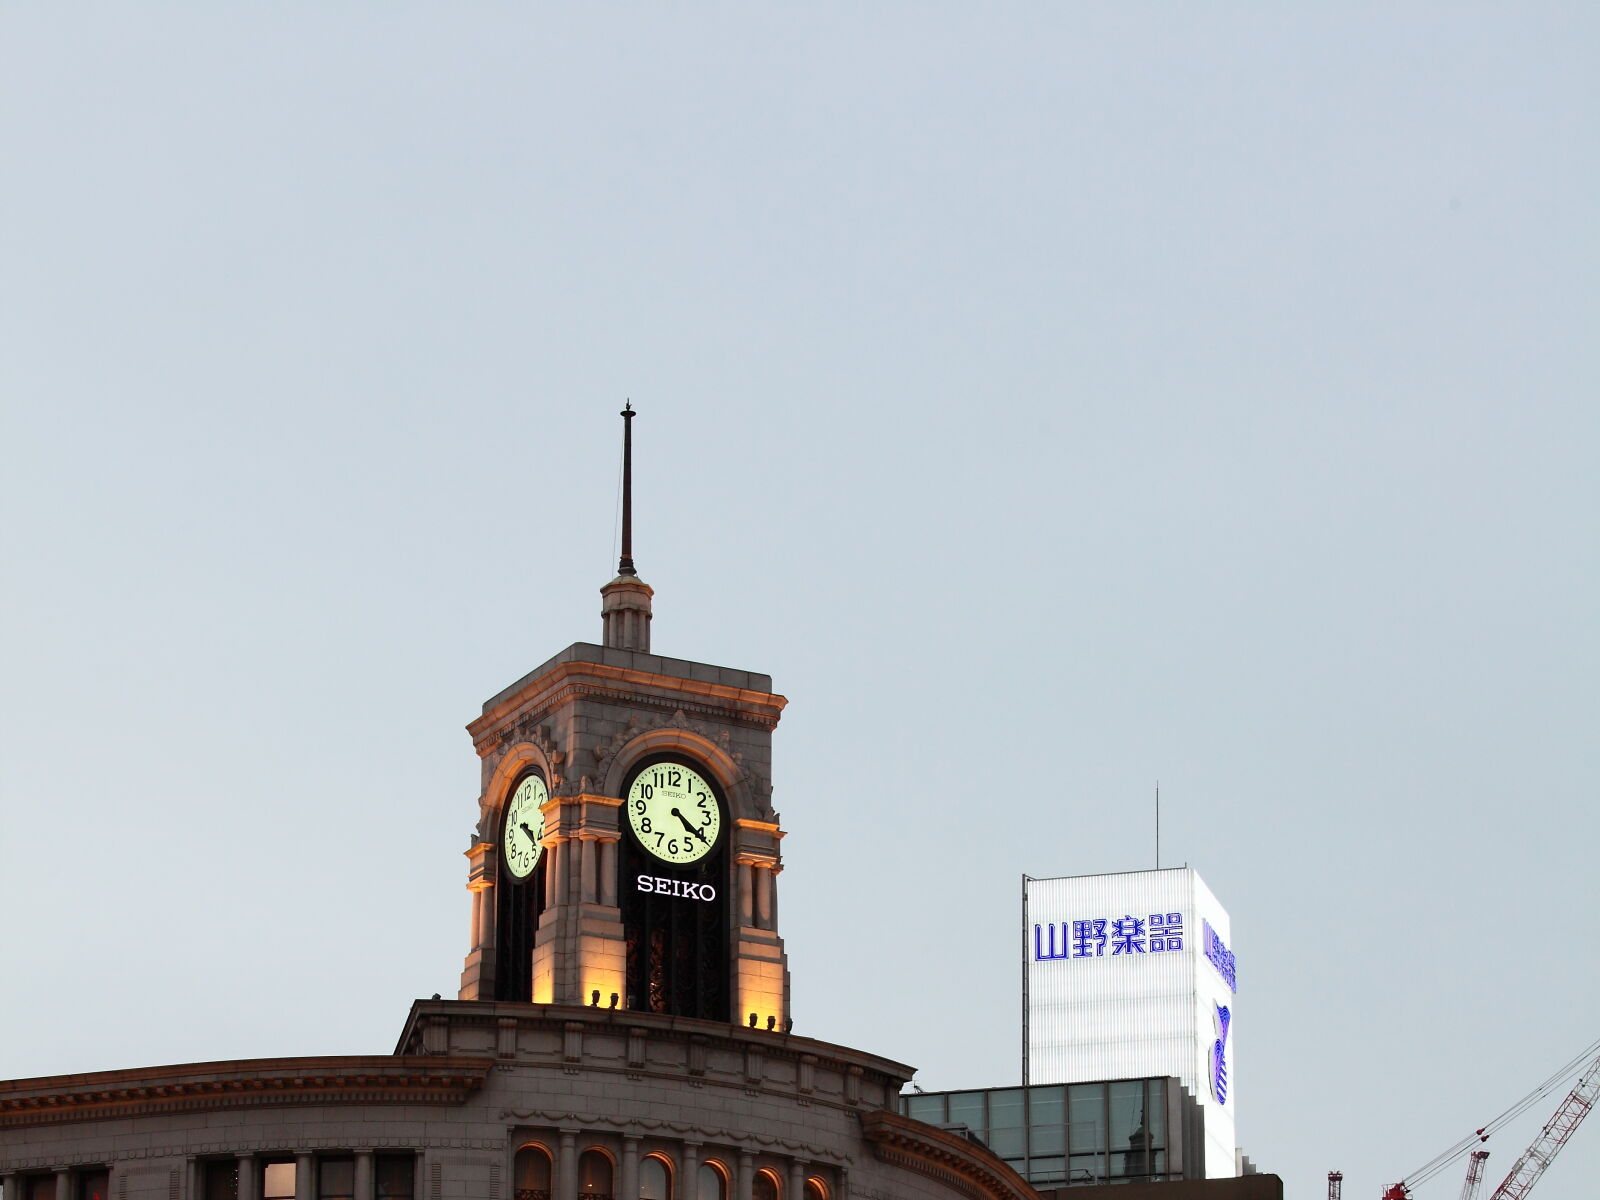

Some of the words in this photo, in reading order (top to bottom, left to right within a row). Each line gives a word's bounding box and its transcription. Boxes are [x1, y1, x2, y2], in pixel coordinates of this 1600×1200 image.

[653, 772, 664, 789] 11
[668, 771, 682, 787] 12
[687, 778, 692, 794] 1
[524, 784, 531, 802] 12
[534, 785, 537, 800] 1
[640, 783, 653, 800] 10
[661, 790, 686, 800] SEIKO
[517, 792, 523, 810] 11
[635, 800, 647, 815] 9
[696, 792, 707, 808] 2
[511, 809, 517, 827] 10
[640, 817, 652, 834] 8
[701, 810, 712, 826] 3
[508, 829, 514, 844] 9
[654, 832, 665, 848] 7
[683, 837, 694, 852] 5
[510, 843, 517, 860] 8
[531, 844, 537, 860] 5
[667, 839, 678, 854] 6
[517, 851, 523, 867] 7
[523, 852, 529, 868] 6
[637, 874, 716, 902] SEIKO
[1035, 912, 1183, 962] 山野楽器
